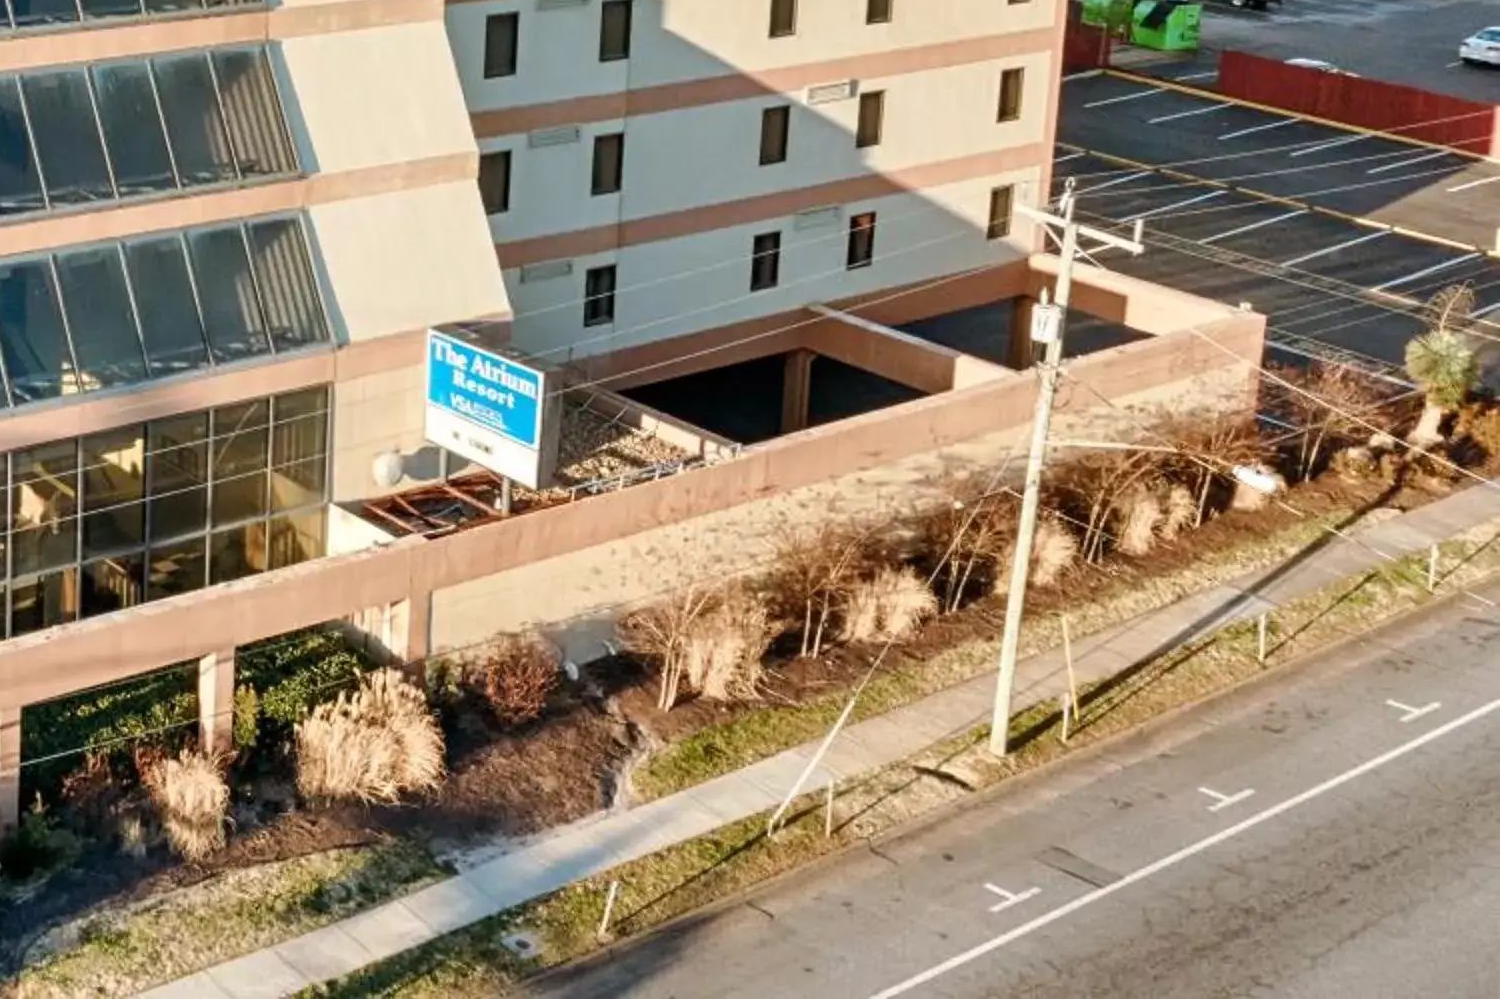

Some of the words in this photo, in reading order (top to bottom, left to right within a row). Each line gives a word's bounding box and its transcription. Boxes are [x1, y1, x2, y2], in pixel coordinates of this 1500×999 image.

[431, 336, 468, 370] The
[470, 353, 538, 400] Atrium
[452, 368, 515, 409] Resort
